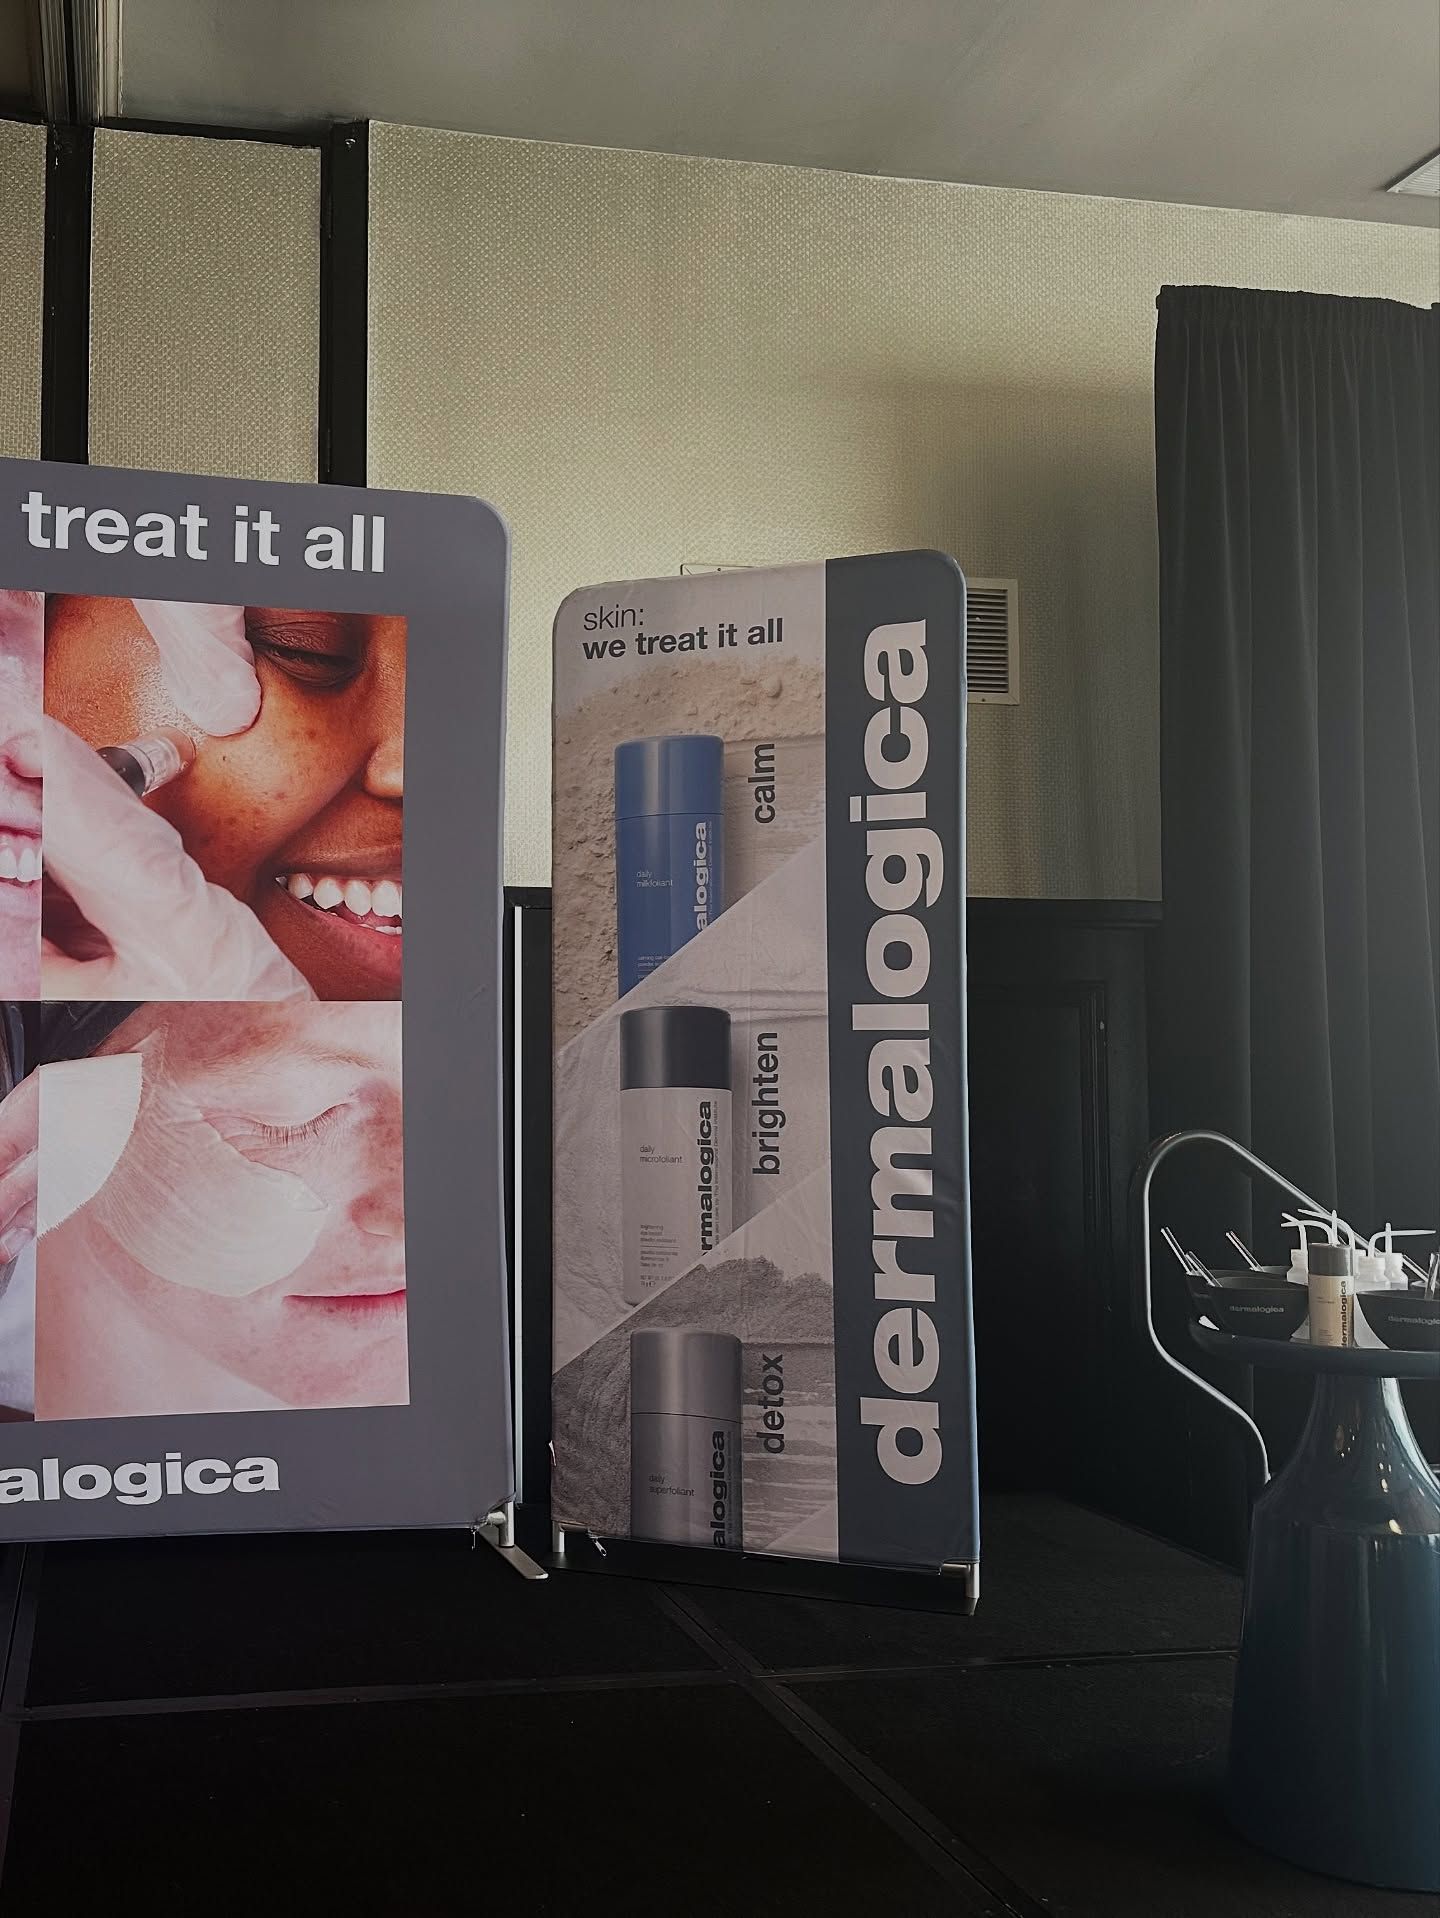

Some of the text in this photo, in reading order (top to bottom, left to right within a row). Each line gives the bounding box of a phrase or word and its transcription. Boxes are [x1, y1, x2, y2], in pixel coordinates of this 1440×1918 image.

[21, 491, 385, 573] treat it all
[582, 617, 783, 660] we treat it all
[583, 604, 644, 631] skin:
[748, 743, 776, 824] calm
[693, 822, 709, 931] alogica
[849, 618, 944, 1486] dermalogica
[752, 1032, 786, 1175] brighten
[697, 1100, 714, 1256] rmalogica
[756, 1353, 785, 1454] detox
[0, 1452, 280, 1506] alogica
[710, 1431, 727, 1548] alogica
